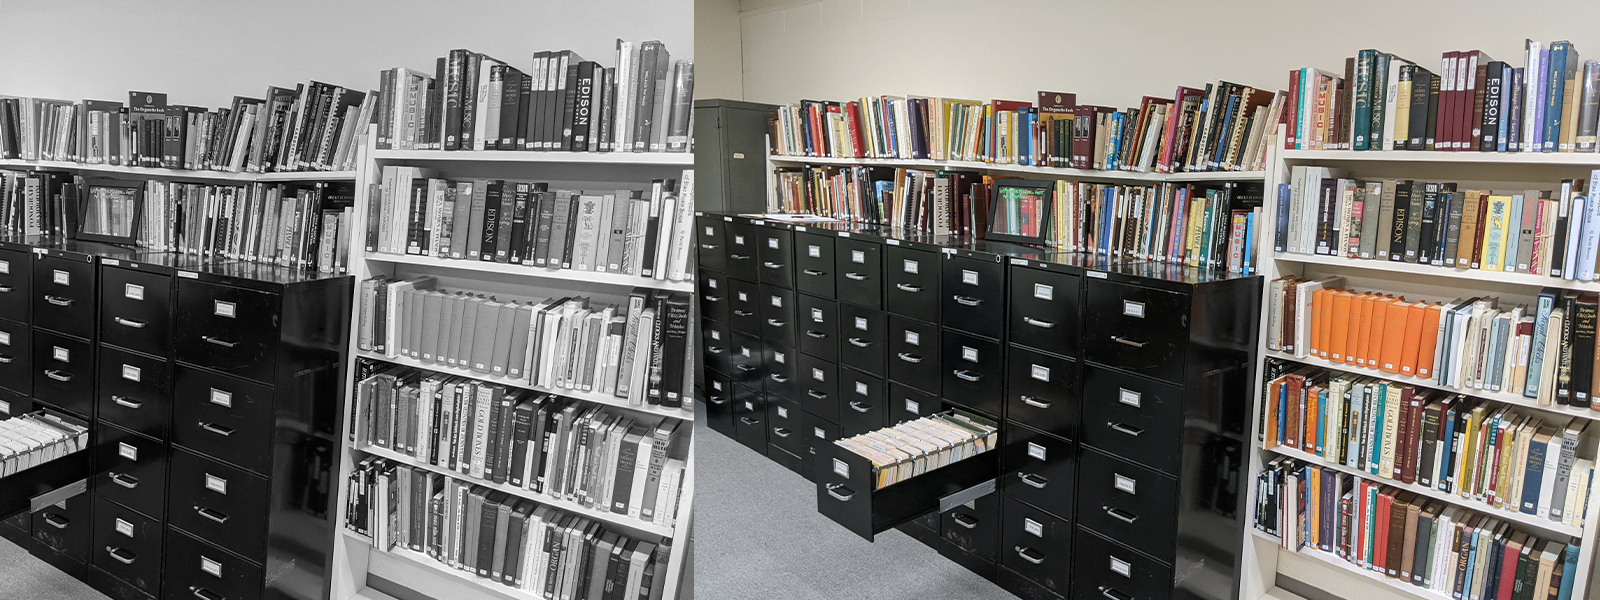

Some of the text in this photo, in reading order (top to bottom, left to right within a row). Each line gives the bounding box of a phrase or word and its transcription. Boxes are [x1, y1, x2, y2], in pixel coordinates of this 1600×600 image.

[408, 92, 417, 128] MUSIC
[579, 78, 590, 125] EDISON
[1317, 92, 1326, 128] MUSIC
[1372, 100, 1382, 128] MUSIC
[1488, 78, 1499, 125] EDISON
[485, 208, 496, 243] EDISON
[1233, 225, 1241, 259] MUSIC
[1394, 208, 1405, 243] EDISON
[1383, 410, 1394, 455] GOLD BOXES
[549, 541, 560, 571] ORGAN
[1458, 541, 1469, 571] ORGAN
